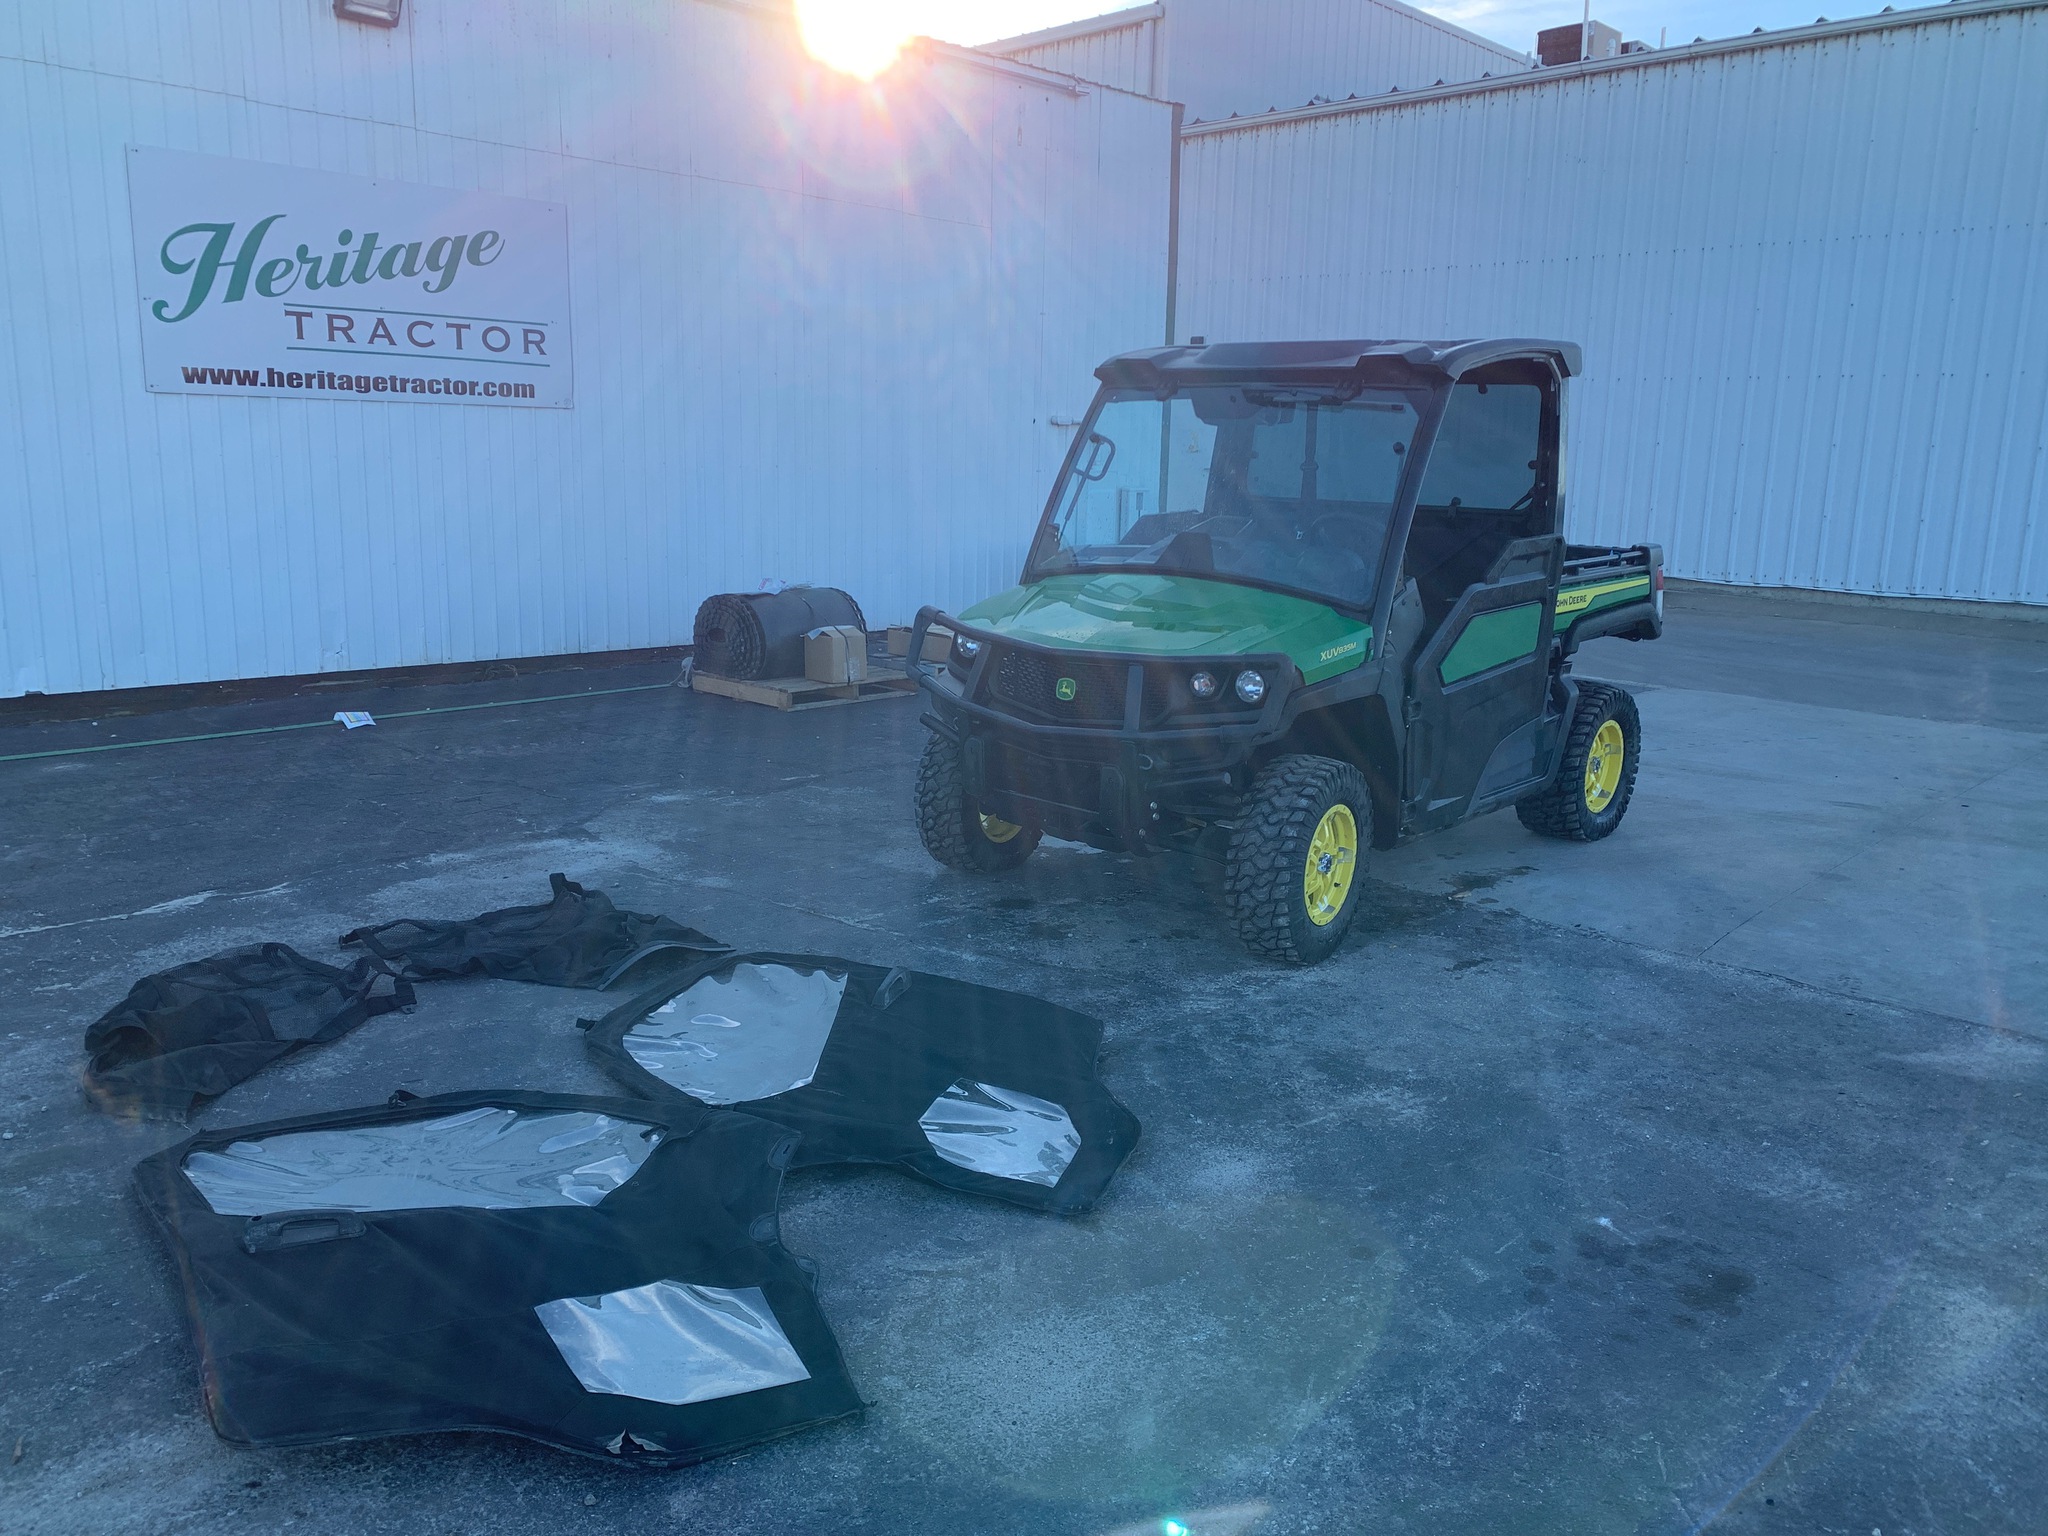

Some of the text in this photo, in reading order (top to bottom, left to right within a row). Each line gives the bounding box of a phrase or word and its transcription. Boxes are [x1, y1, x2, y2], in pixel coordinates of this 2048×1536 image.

[152, 214, 505, 323] Heritage
[284, 309, 547, 356] TRACTOR
[181, 366, 536, 399] www.heritagetractor.com
[1556, 594, 1588, 608] OHN DEERE
